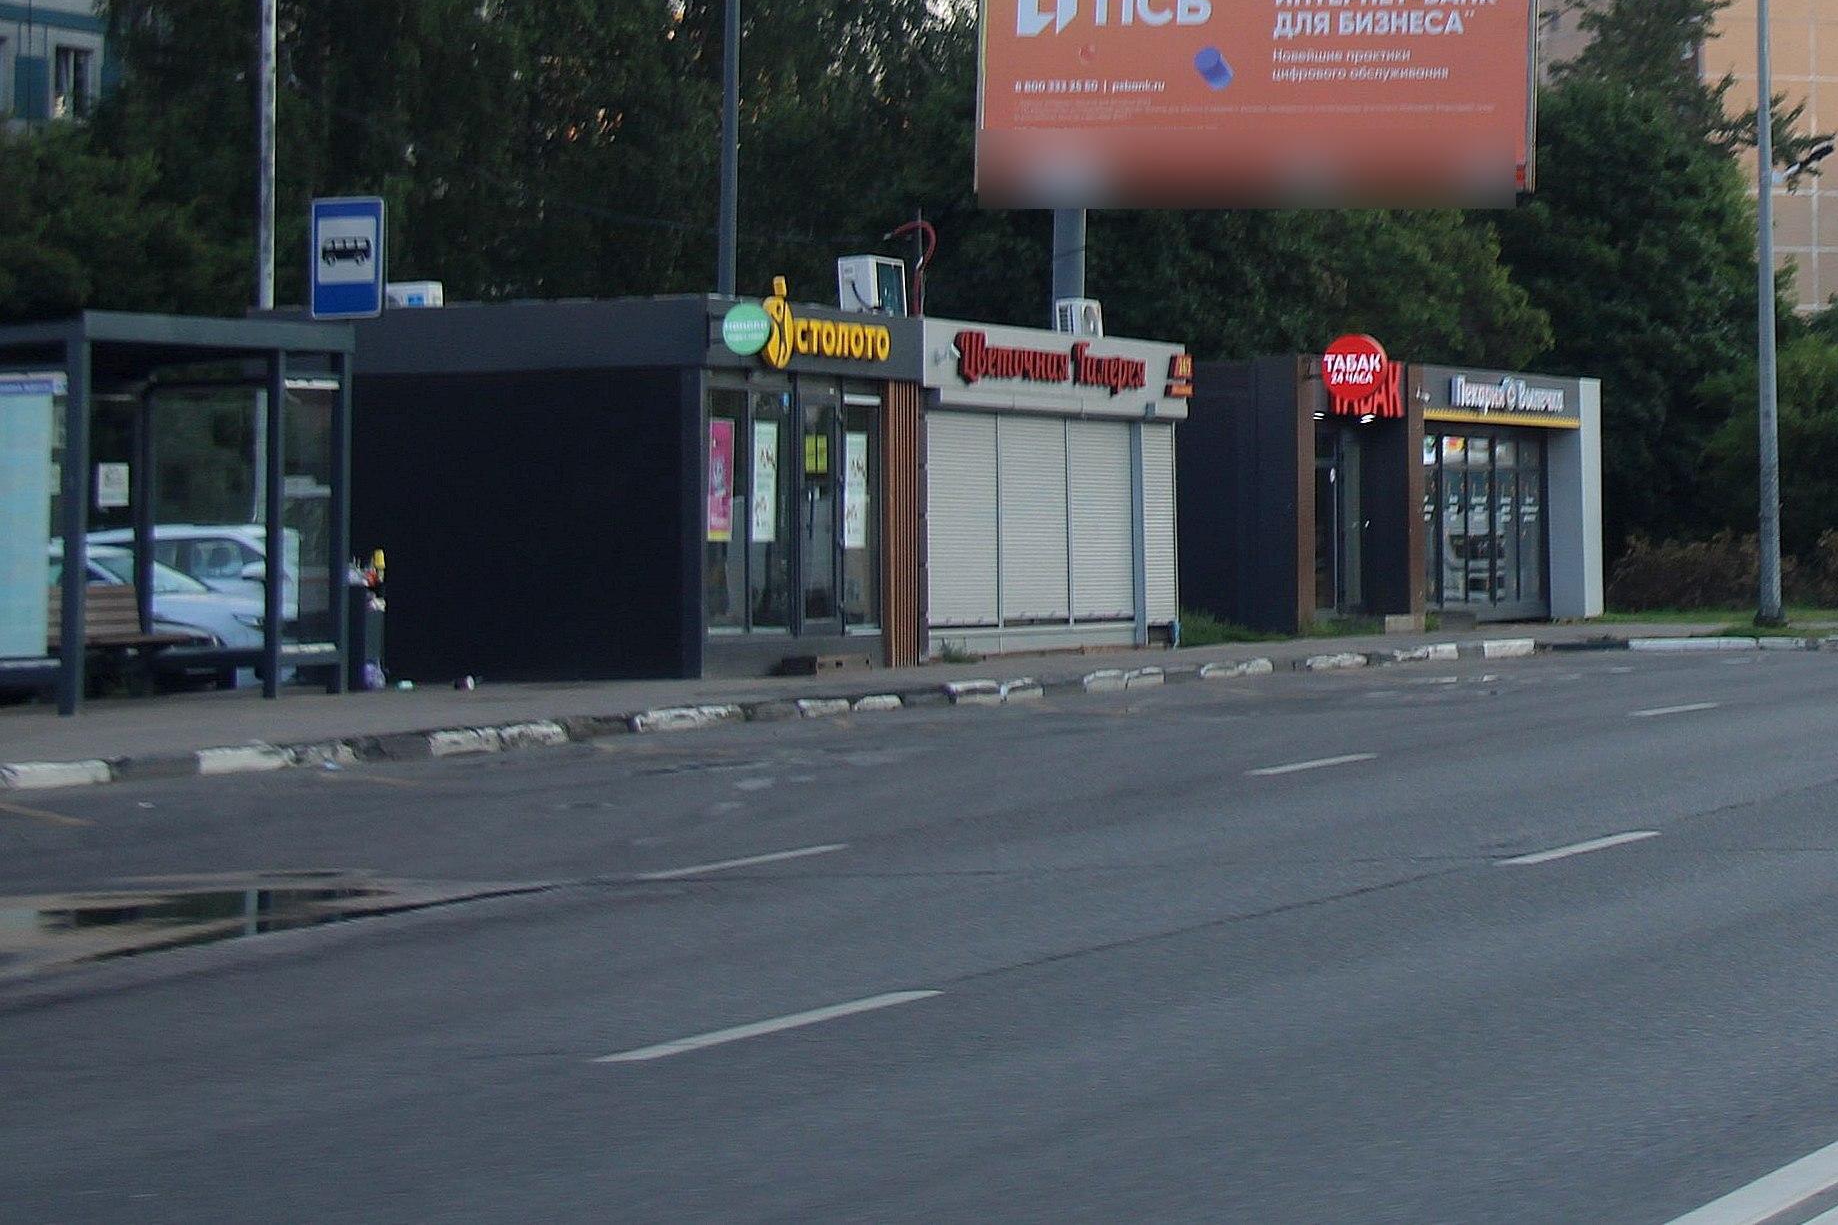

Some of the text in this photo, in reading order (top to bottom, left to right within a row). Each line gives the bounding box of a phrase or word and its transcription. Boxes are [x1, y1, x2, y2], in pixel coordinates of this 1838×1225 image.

[1272, 10, 1331, 41] ДЛЯ
[1272, 47, 1413, 65] Новейшие практики
[1271, 66, 1449, 83] цифрового обслуживания
[953, 330, 1147, 395] Цветочная Галерея
[1323, 353, 1382, 373] ТАБАК
